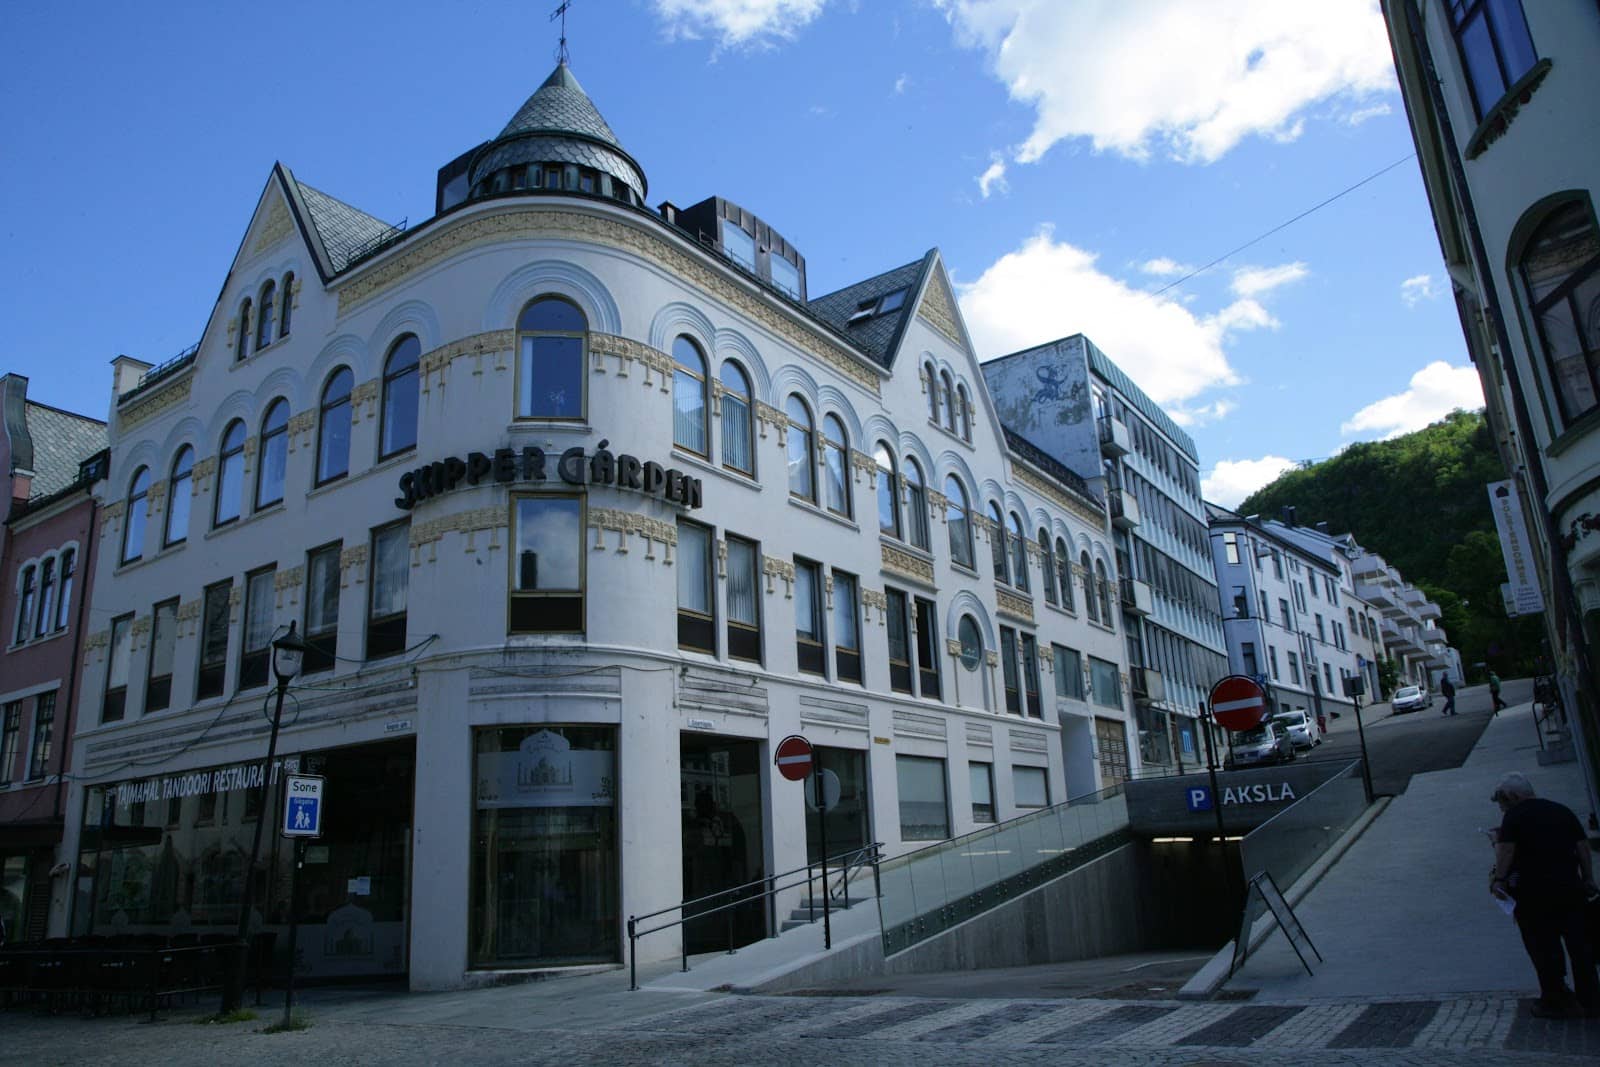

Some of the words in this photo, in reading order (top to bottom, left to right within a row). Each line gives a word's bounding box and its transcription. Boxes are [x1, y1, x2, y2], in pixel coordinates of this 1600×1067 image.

[162, 772, 211, 799] TANDOORI
[293, 780, 317, 793] Sone
[1190, 789, 1206, 808] P
[1223, 782, 1296, 806] AKSLA
